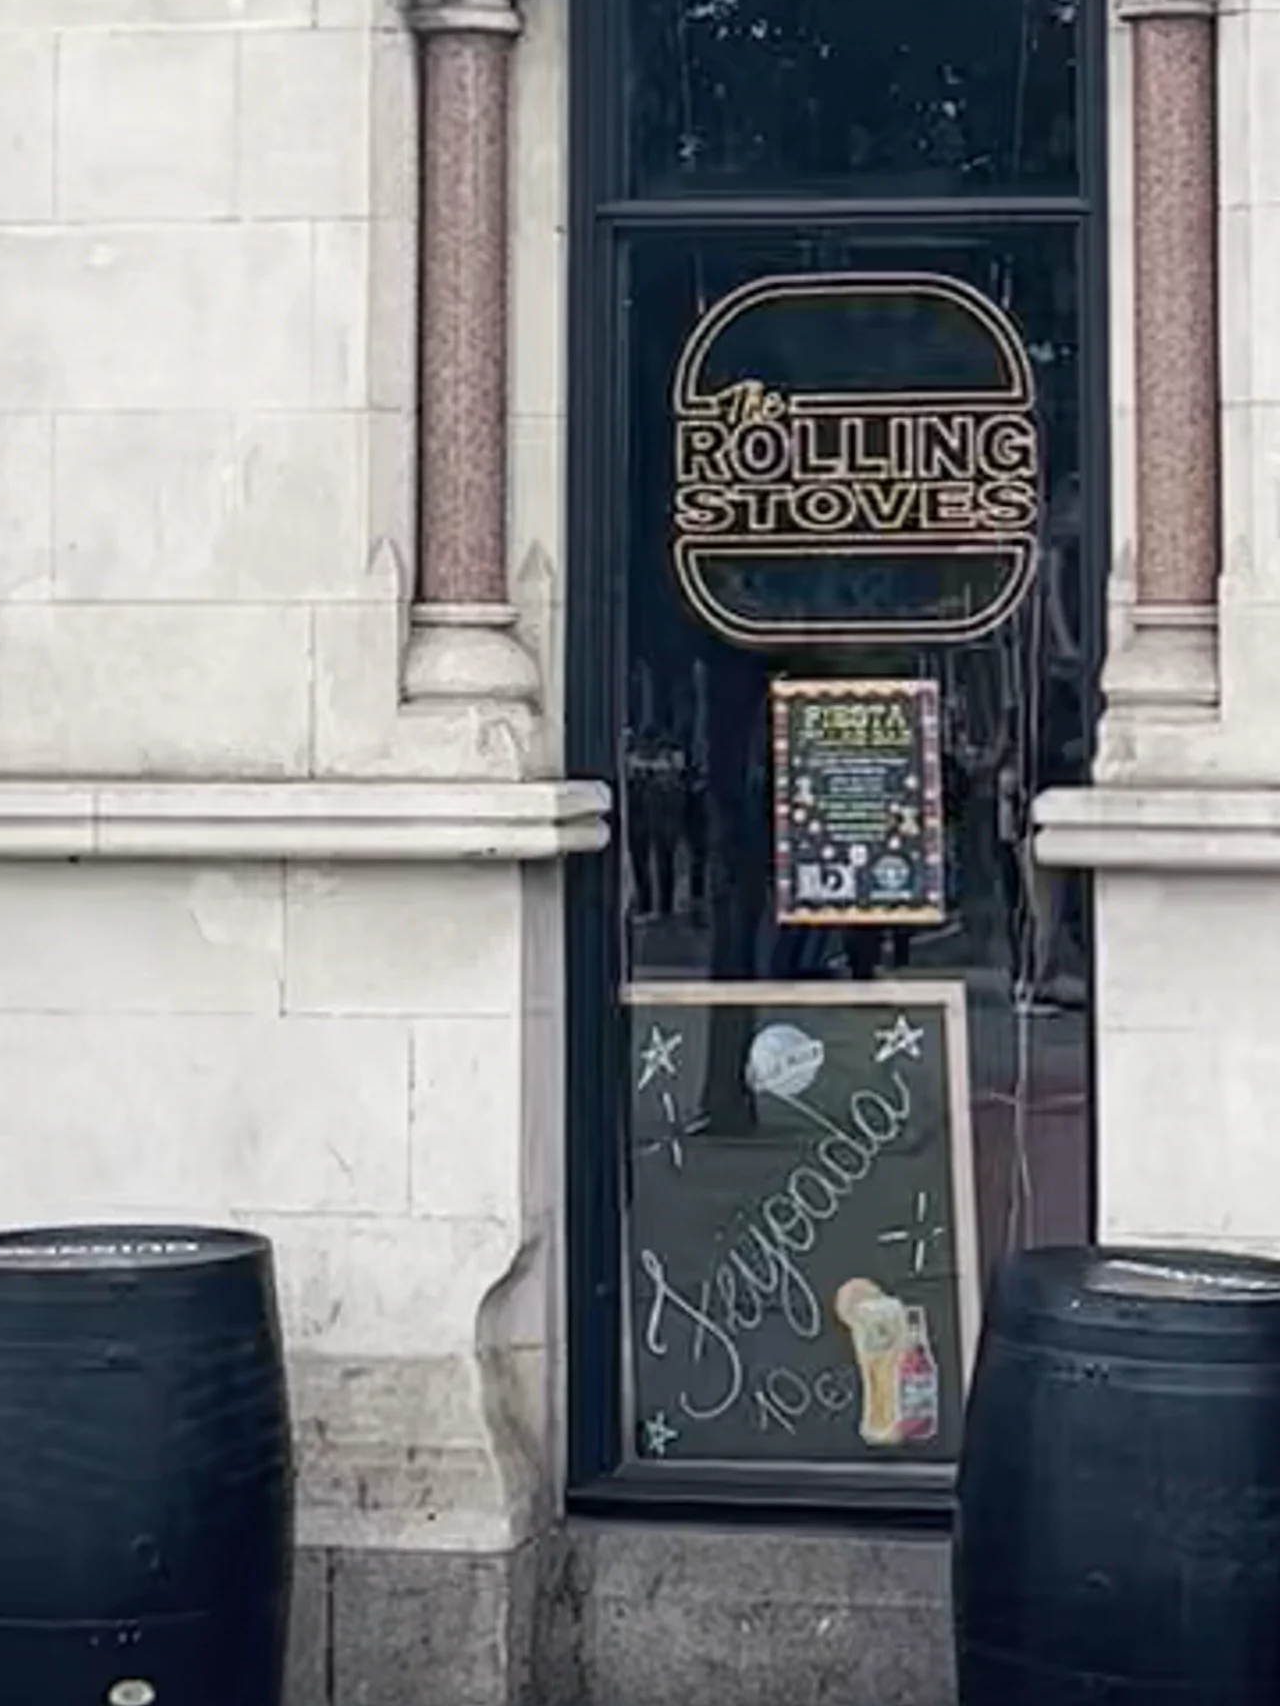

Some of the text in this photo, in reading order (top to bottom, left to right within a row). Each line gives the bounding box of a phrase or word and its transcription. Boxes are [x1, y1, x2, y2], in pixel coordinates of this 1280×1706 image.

[718, 379, 786, 424] The
[676, 414, 1039, 482] ROLLING
[674, 482, 1038, 531] STOVES
